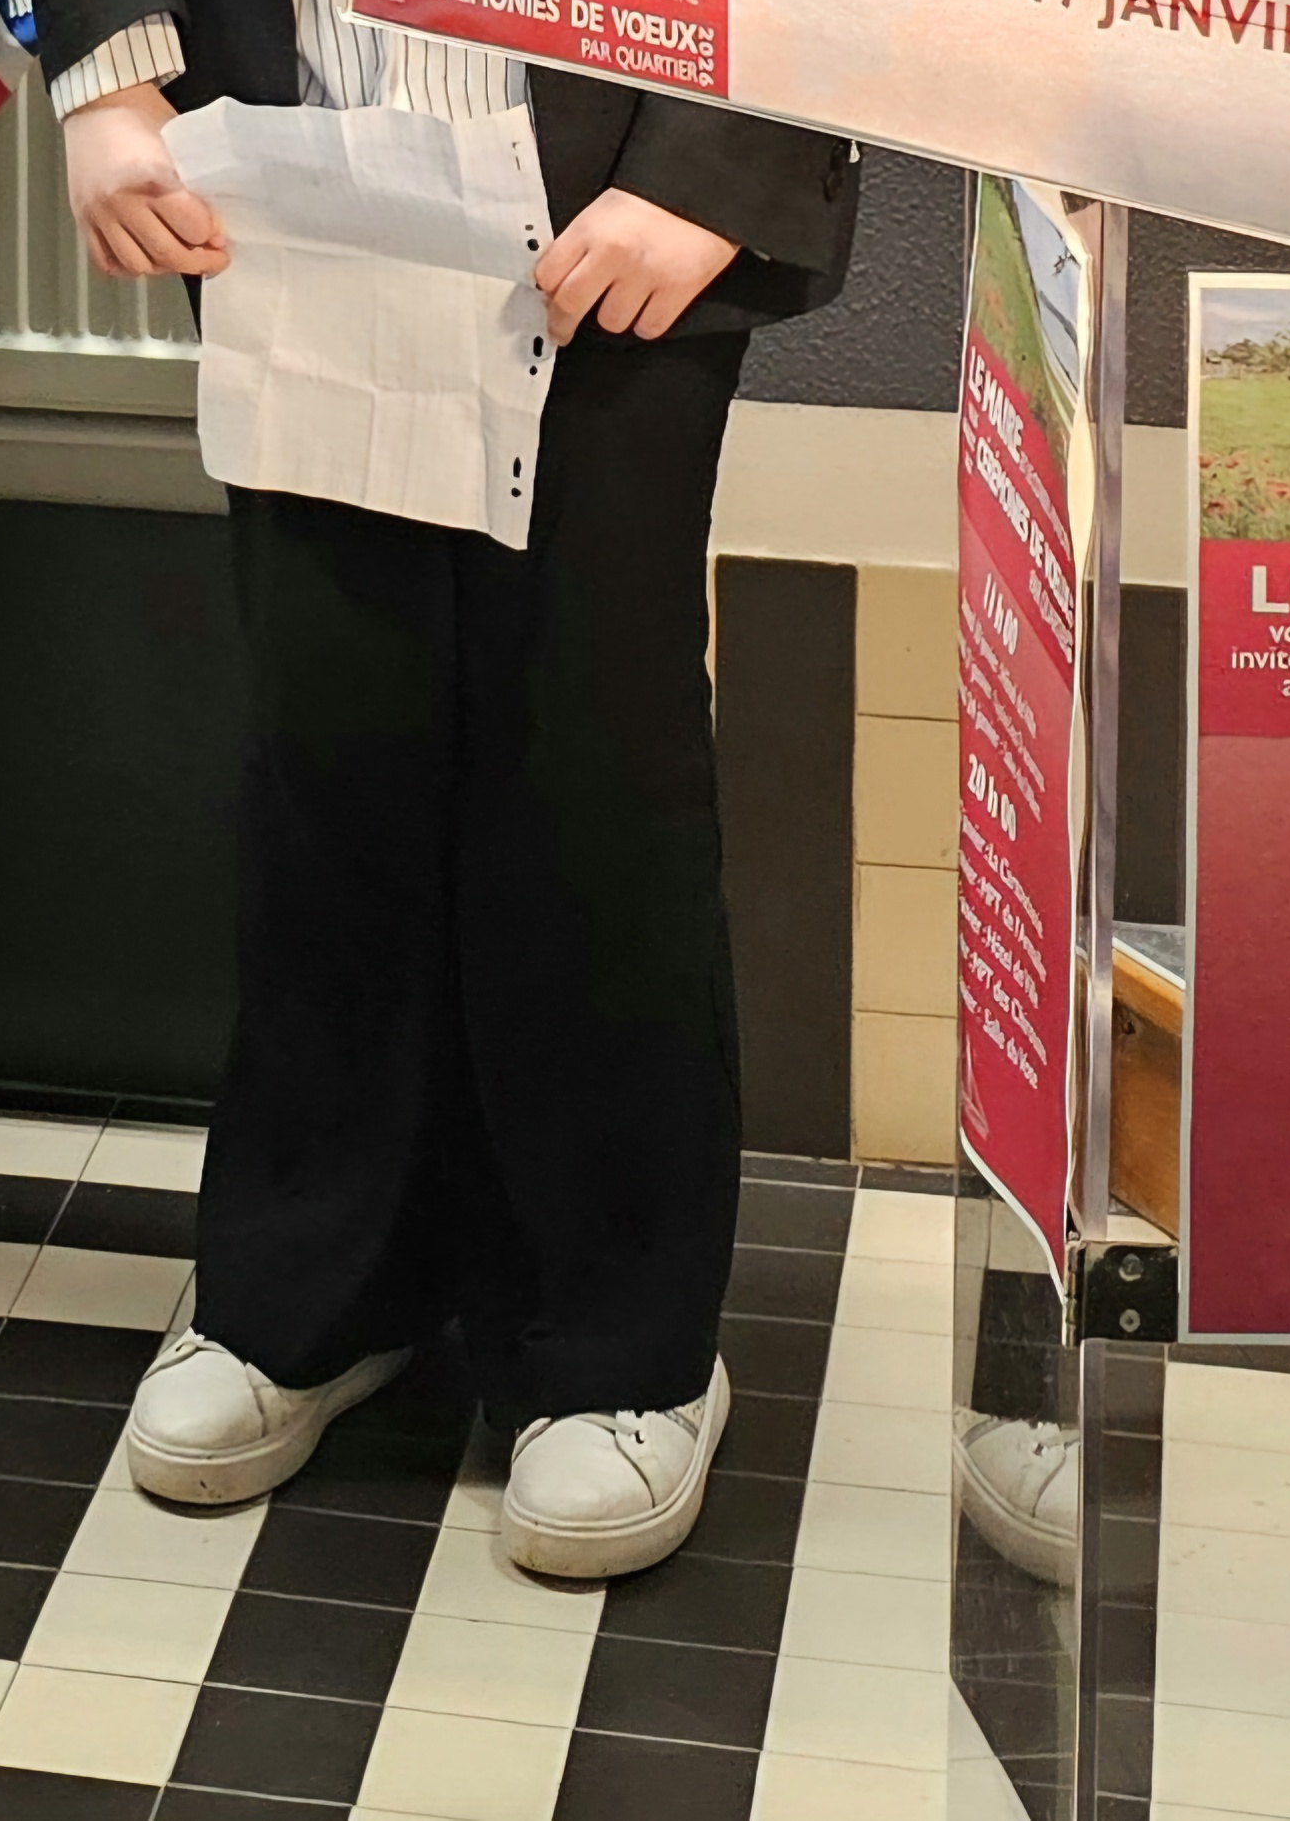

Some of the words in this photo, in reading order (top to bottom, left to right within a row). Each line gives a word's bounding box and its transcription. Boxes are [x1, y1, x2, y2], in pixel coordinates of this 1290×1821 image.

[611, 6, 699, 54] VOEUX
[581, 38, 611, 62] PAR
[616, 46, 699, 83] QUARTIER
[698, 26, 714, 87] 2026
